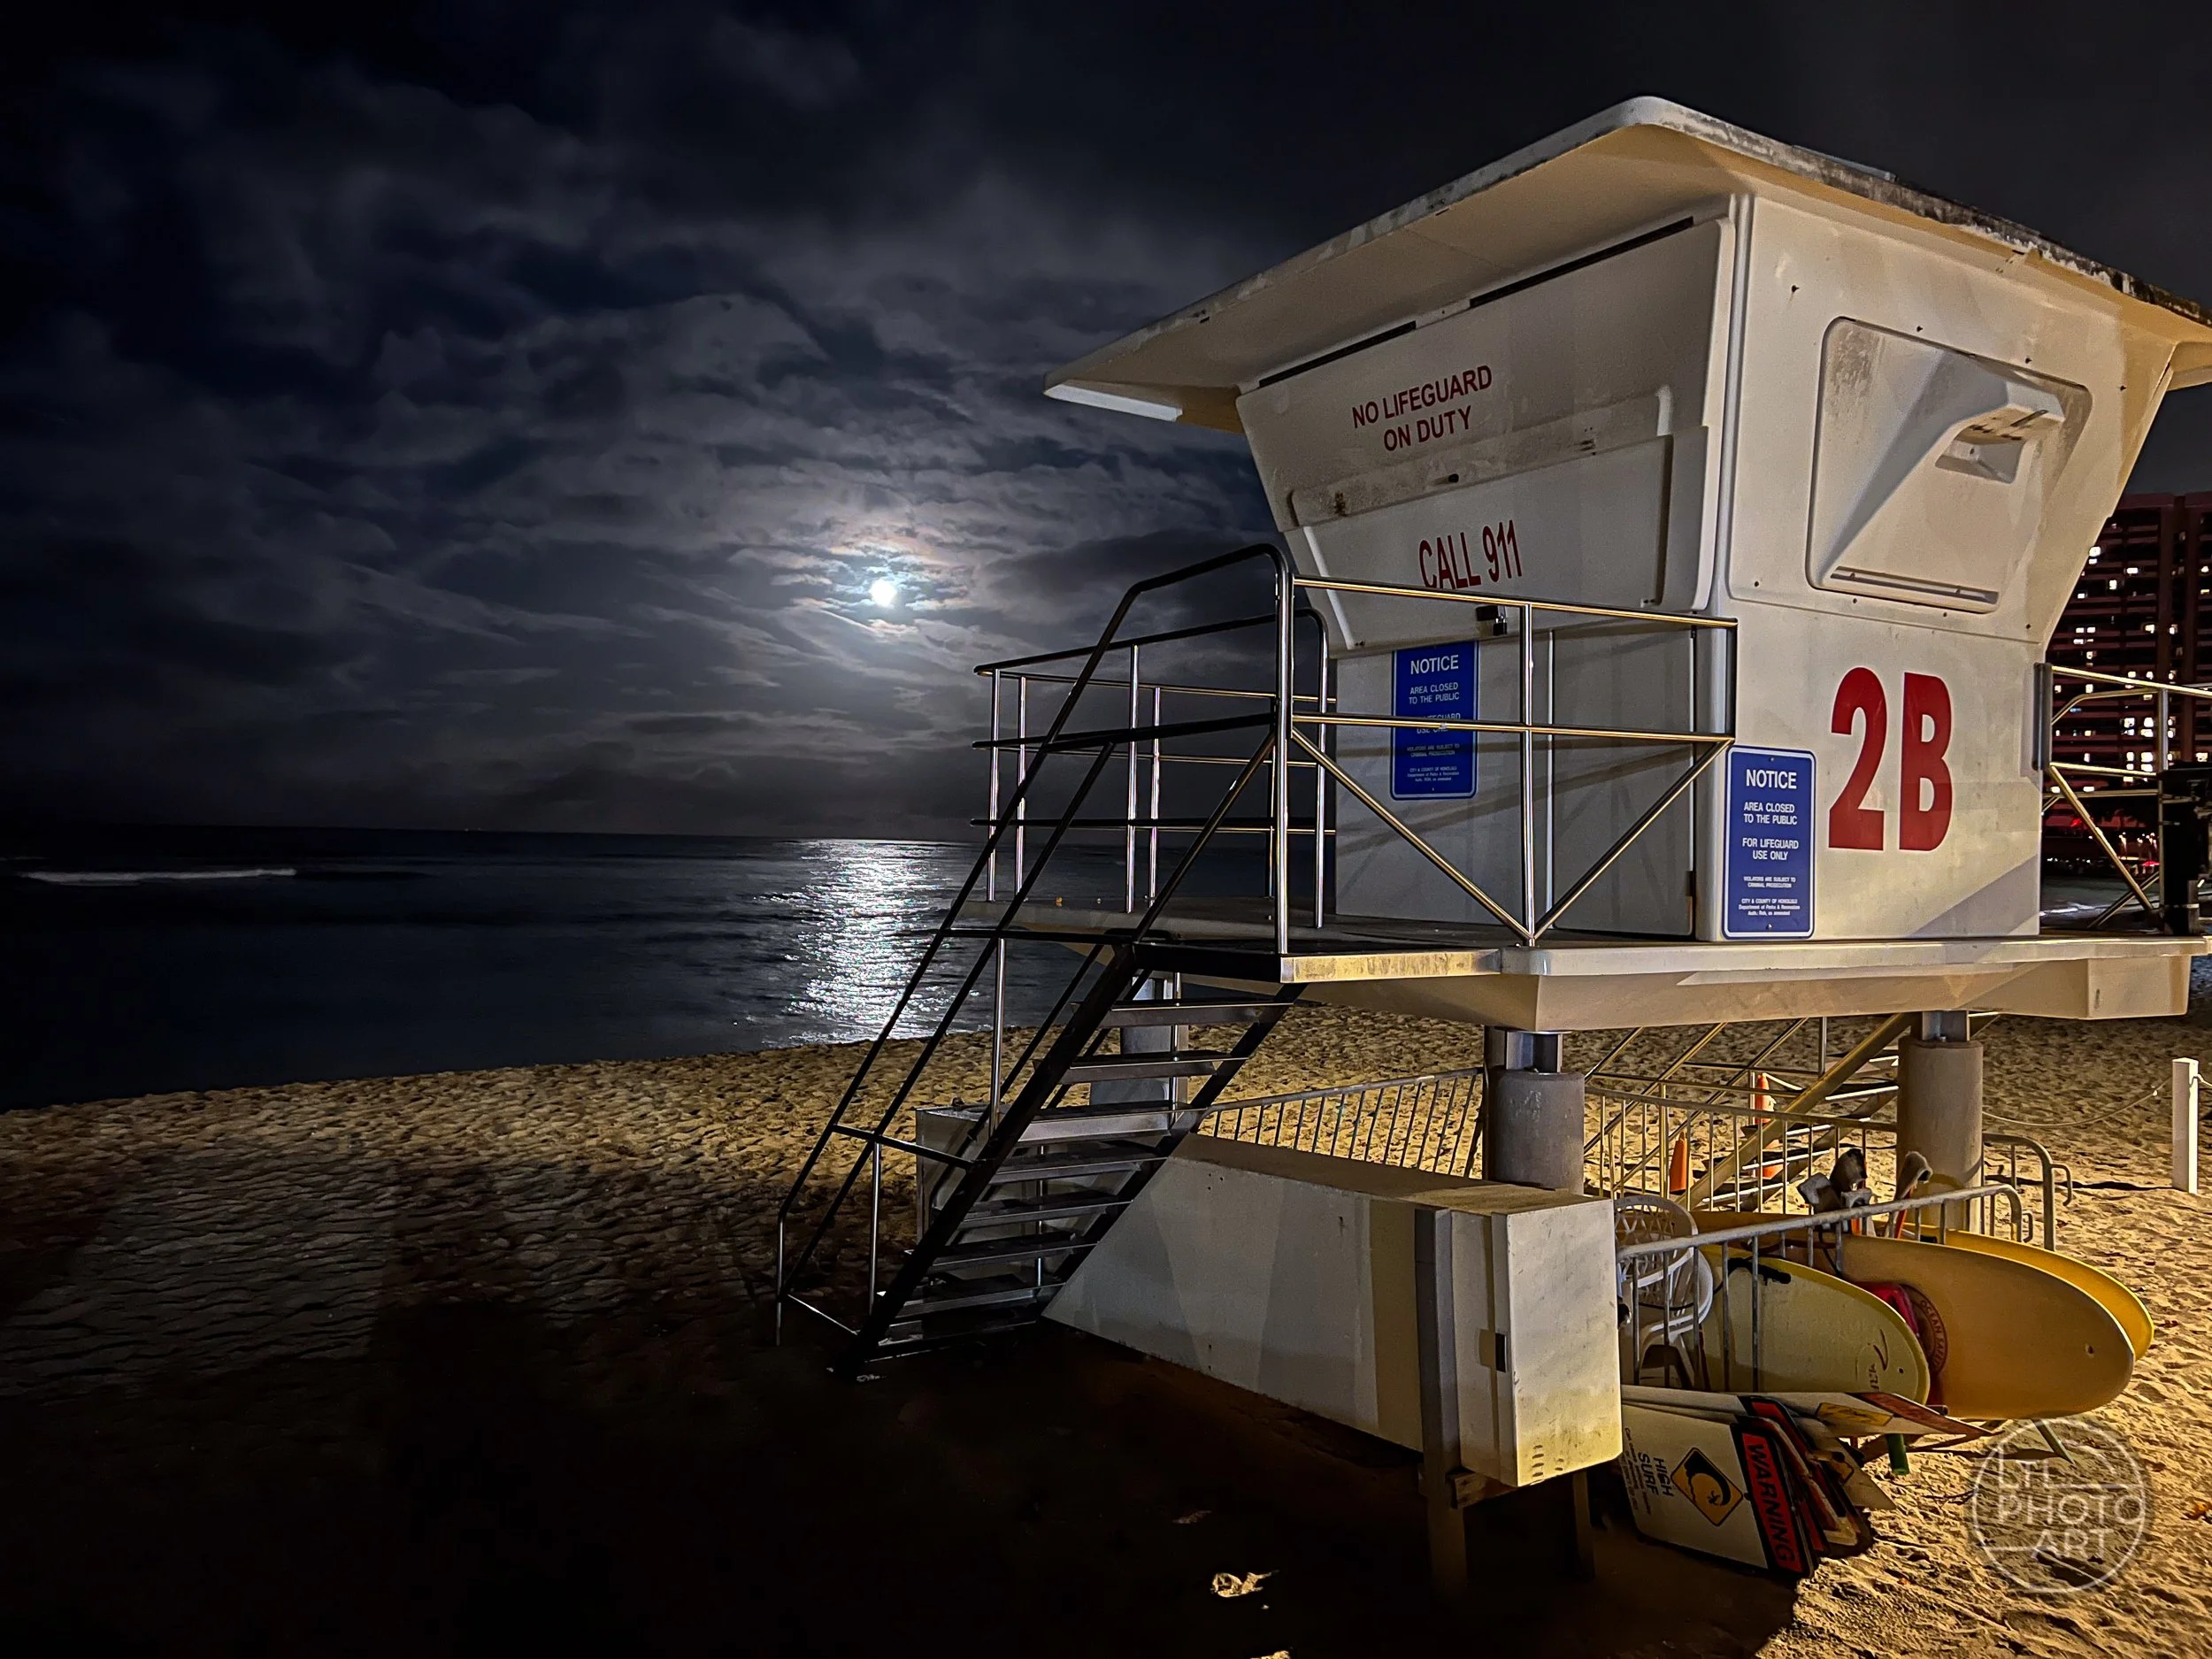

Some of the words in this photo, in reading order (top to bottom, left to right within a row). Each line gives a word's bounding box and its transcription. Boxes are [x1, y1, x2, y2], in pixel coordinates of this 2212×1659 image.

[1352, 402, 1379, 428] NO
[1383, 365, 1493, 419] LIFEGUARD
[1384, 425, 1411, 451] ON
[1417, 405, 1471, 442] DUTY
[1419, 532, 1481, 589] CALL
[1482, 519, 1522, 582] 911
[1410, 655, 1459, 674] NOTICE
[1410, 686, 1428, 695] AREA
[1430, 682, 1458, 693] CLOSED
[1420, 695, 1432, 703] THE
[1435, 692, 1460, 702] PUBLIC
[1828, 666, 1953, 851] 2B
[1746, 769, 1797, 789] NOTICE
[1744, 802, 1763, 811] AREA
[1766, 803, 1795, 813] CLOSED
[1744, 813, 1754, 824] TO
[1756, 814, 1770, 824] THE
[1772, 816, 1798, 826] PUBLIC
[1742, 837, 1757, 848] FOR
[1760, 838, 1799, 849] LIFEGUARD
[1753, 850, 1768, 860] USE
[1770, 851, 1788, 861] ONLY
[1920, 1300, 1941, 1333] OCEAN
[1638, 1452, 1659, 1495] SURF
[1654, 1457, 1674, 1497] HIGH
[1747, 1443, 1795, 1563] WARNING
